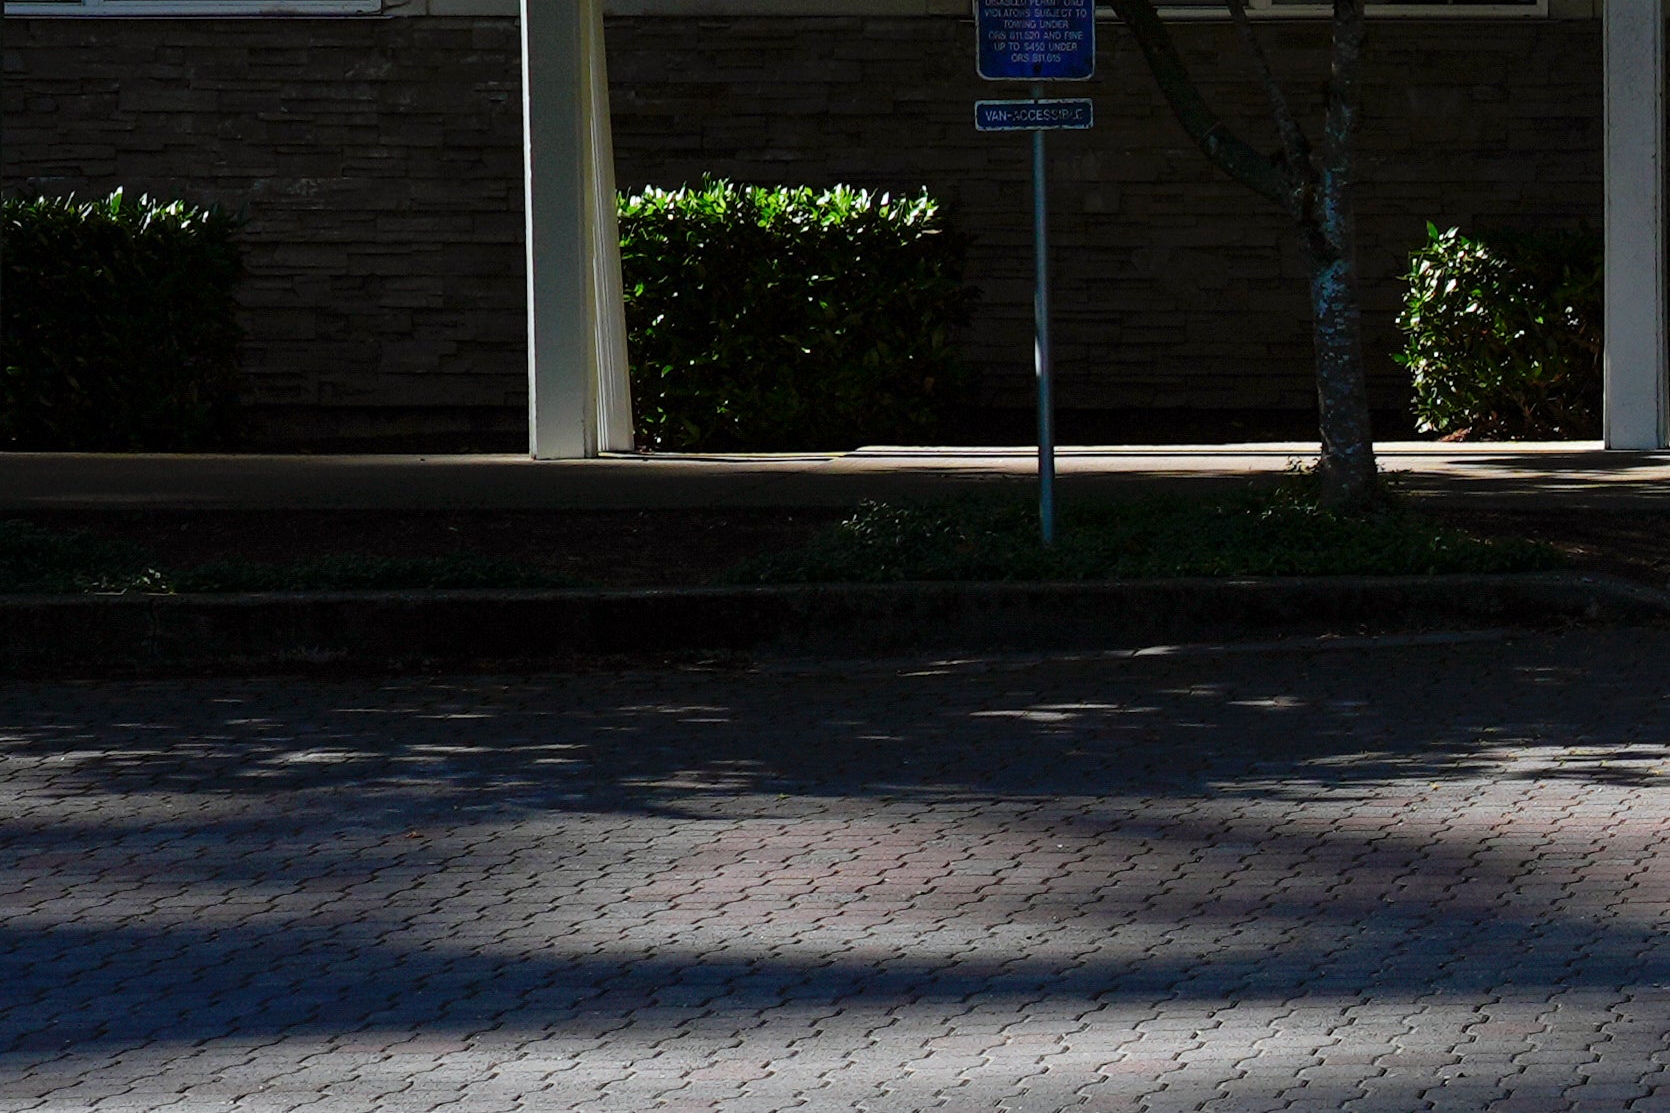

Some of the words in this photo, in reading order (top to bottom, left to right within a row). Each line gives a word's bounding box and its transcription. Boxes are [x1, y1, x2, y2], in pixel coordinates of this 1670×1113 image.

[984, 8, 1031, 17] VIOLATORS
[1034, 8, 1072, 17] SUBJECT
[1075, 8, 1087, 17] TO
[1003, 19, 1037, 29] TOWING
[1040, 19, 1069, 29] UNDER
[988, 30, 1006, 40] ORS
[1043, 30, 1061, 40] AND
[1064, 30, 1084, 40] FINE
[993, 41, 1006, 51] UP
[1008, 41, 1020, 51] TO
[1048, 41, 1078, 51] UNDER
[1010, 53, 1030, 63] ORS
[985, 108, 1083, 122] VAN-ACCESSIBLE
